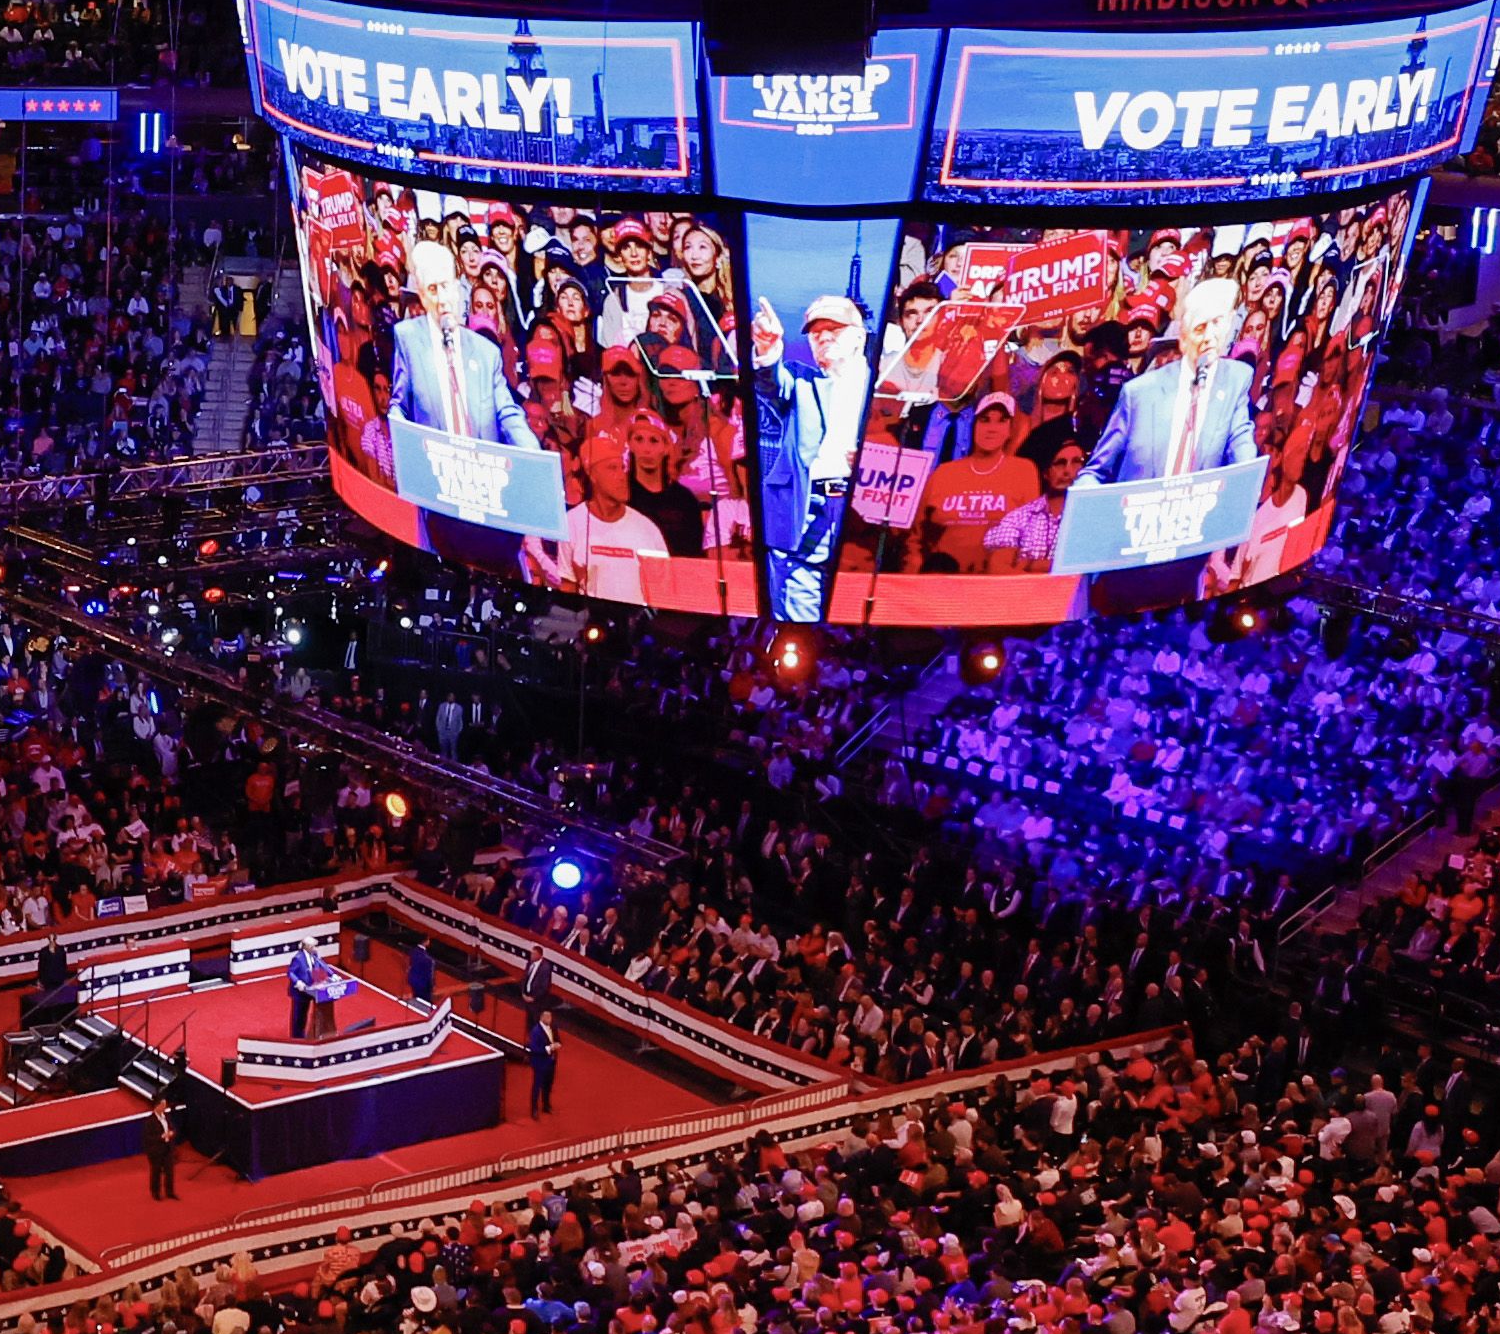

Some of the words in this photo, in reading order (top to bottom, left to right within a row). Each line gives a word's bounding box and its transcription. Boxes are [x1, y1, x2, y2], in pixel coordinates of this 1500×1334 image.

[277, 37, 371, 113] VOTE
[375, 62, 575, 136] EARLY!
[760, 87, 873, 115] VANCE
[1073, 87, 1259, 151] VOTE
[1265, 66, 1437, 145] EARLY!
[320, 191, 355, 217] TRUMP
[1007, 251, 1102, 293] TRUMP
[1005, 285, 1049, 306] WILL
[1052, 276, 1080, 296] FIX
[1083, 272, 1100, 289] IT
[861, 488, 889, 506] FIX
[892, 493, 910, 508] IT
[942, 495, 1006, 512] ULTRA
